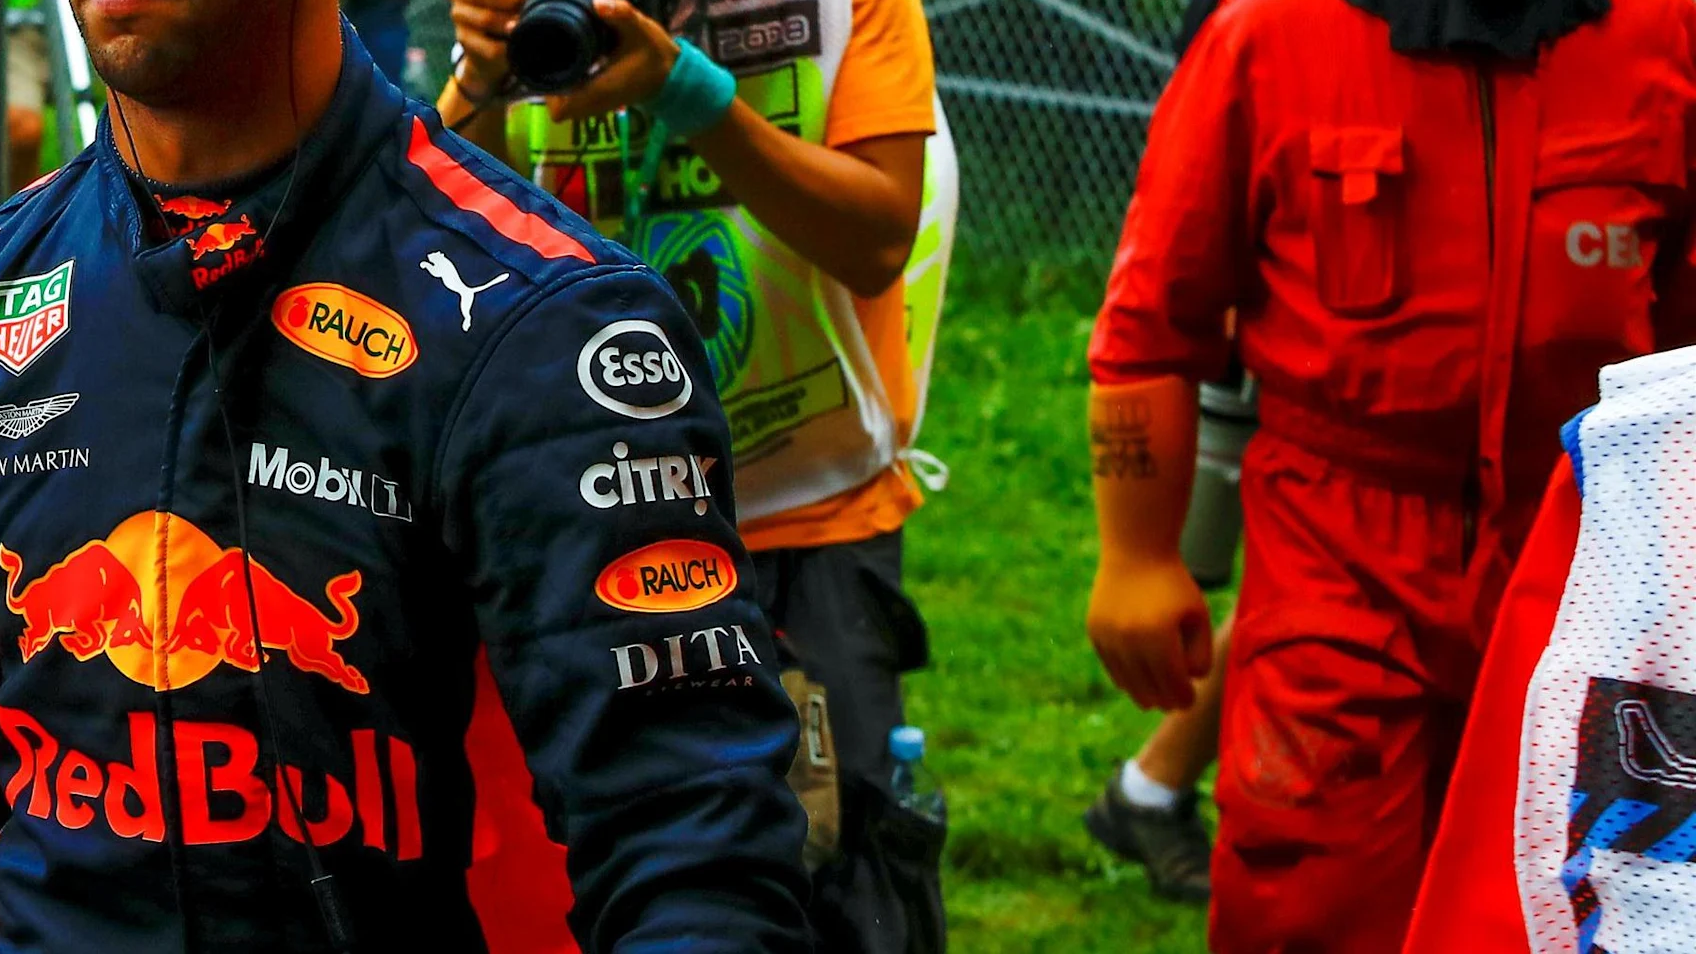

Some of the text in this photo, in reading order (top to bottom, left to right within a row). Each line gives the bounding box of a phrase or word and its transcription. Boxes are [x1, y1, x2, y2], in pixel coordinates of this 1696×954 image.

[308, 302, 406, 365] RAUCH
[13, 448, 90, 474] MARTIN
[247, 442, 367, 508] Mobil
[639, 558, 722, 596] RAUCH
[609, 625, 762, 690] DITA
[644, 675, 754, 697] EWEAR
